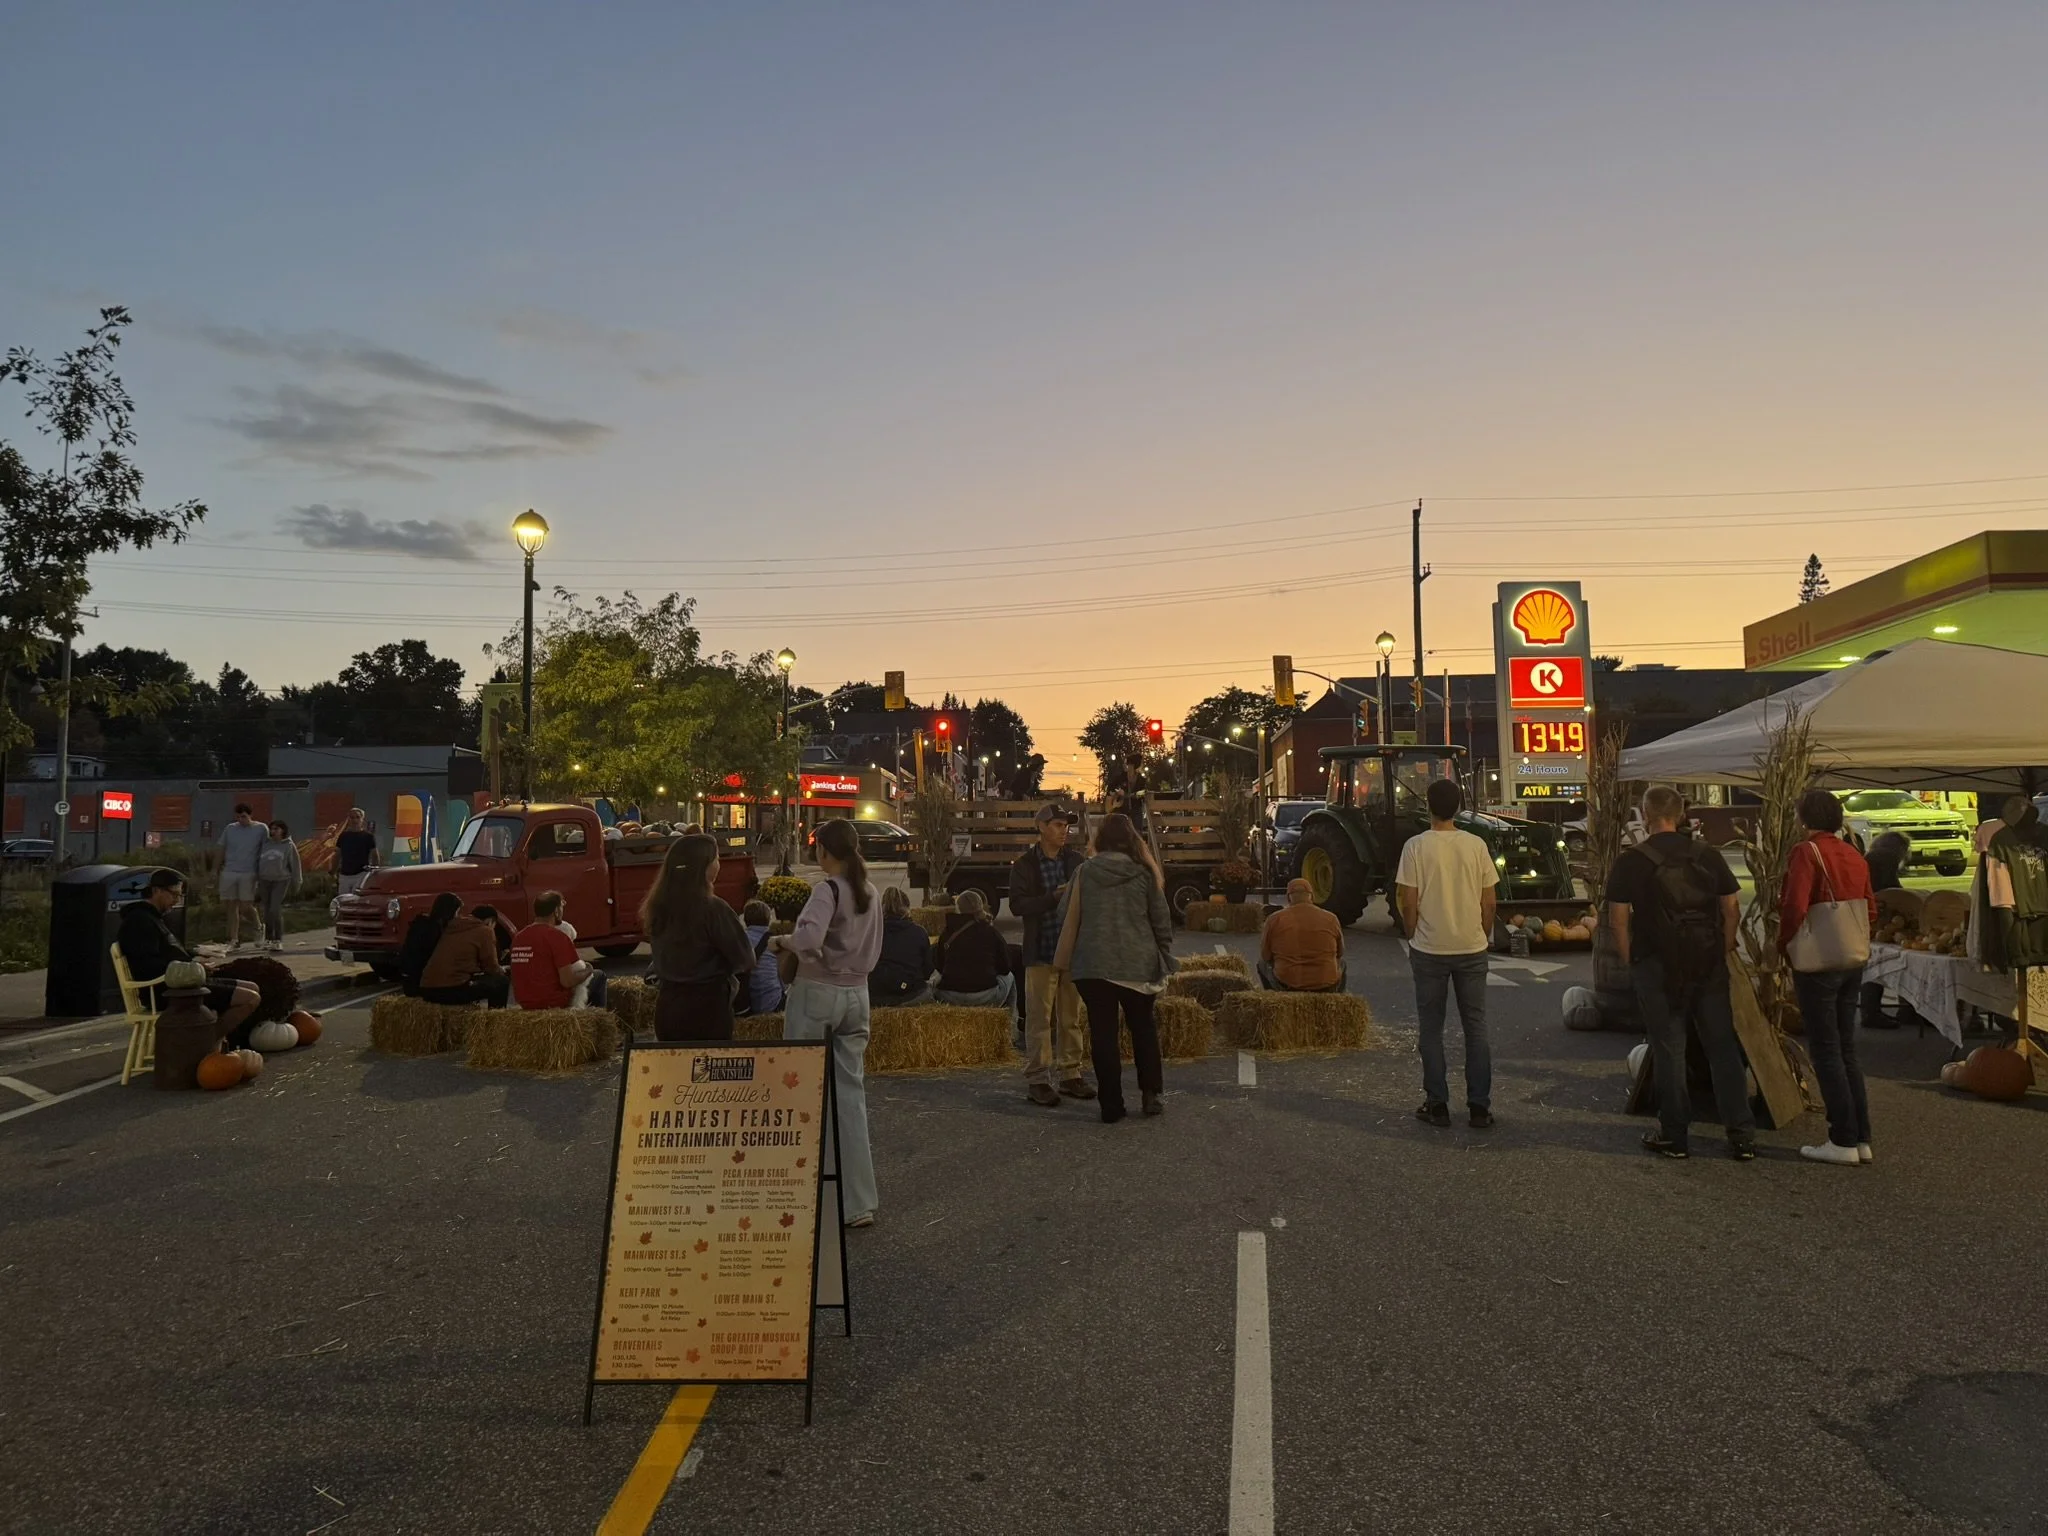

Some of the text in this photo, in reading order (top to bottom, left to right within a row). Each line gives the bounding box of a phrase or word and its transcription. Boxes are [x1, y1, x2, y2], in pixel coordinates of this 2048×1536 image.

[1759, 620, 1810, 660] Shell
[1540, 669, 1560, 692] K
[1521, 722, 1584, 752] 134.9
[1518, 765, 1568, 774] 24 Hours
[837, 782, 857, 790] Centre
[1523, 786, 1550, 796] ATM
[104, 799, 124, 810] CIBC
[712, 1058, 753, 1067] DOWNTOWN
[711, 1068, 753, 1080] HUNTSVILLE
[674, 1084, 771, 1108] Huntsville's
[649, 1108, 794, 1129] HARVEST FEAST
[638, 1130, 802, 1148] ENTERTAINMENT SCHEDULE
[633, 1154, 706, 1165] UPPER MAIN STREET
[743, 1168, 764, 1178] FARM
[766, 1167, 788, 1178] STAGE
[628, 1205, 691, 1216] MAIN/WEST ST.N
[718, 1232, 792, 1242] KING ST. WALKWAY
[624, 1250, 687, 1260] MAIN/WEST ST.S
[619, 1288, 661, 1298] KENT PARK
[714, 1294, 777, 1304] LOWER MAIN ST.
[711, 1332, 800, 1343] THE GREATER MUSKOKA
[613, 1340, 663, 1350] BEAVERTAILS
[710, 1344, 737, 1354] GROUP
